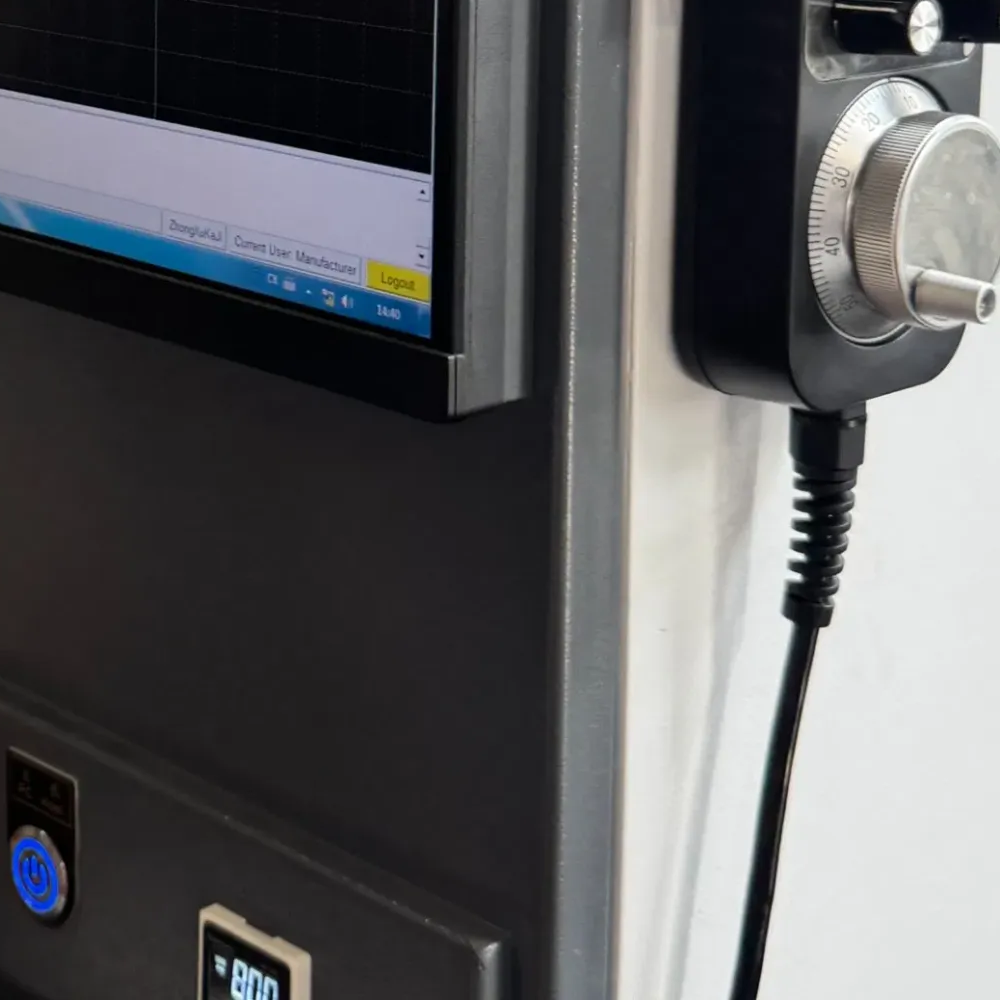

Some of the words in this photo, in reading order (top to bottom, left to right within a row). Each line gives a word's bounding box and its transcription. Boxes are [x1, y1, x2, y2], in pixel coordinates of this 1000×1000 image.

[861, 112, 881, 133] 20
[831, 166, 850, 188] 30
[234, 234, 267, 254] Current
[296, 250, 356, 276] Manufacturer
[825, 236, 840, 256] 40
[381, 271, 416, 292] Logout
[377, 304, 402, 320] 14:40
